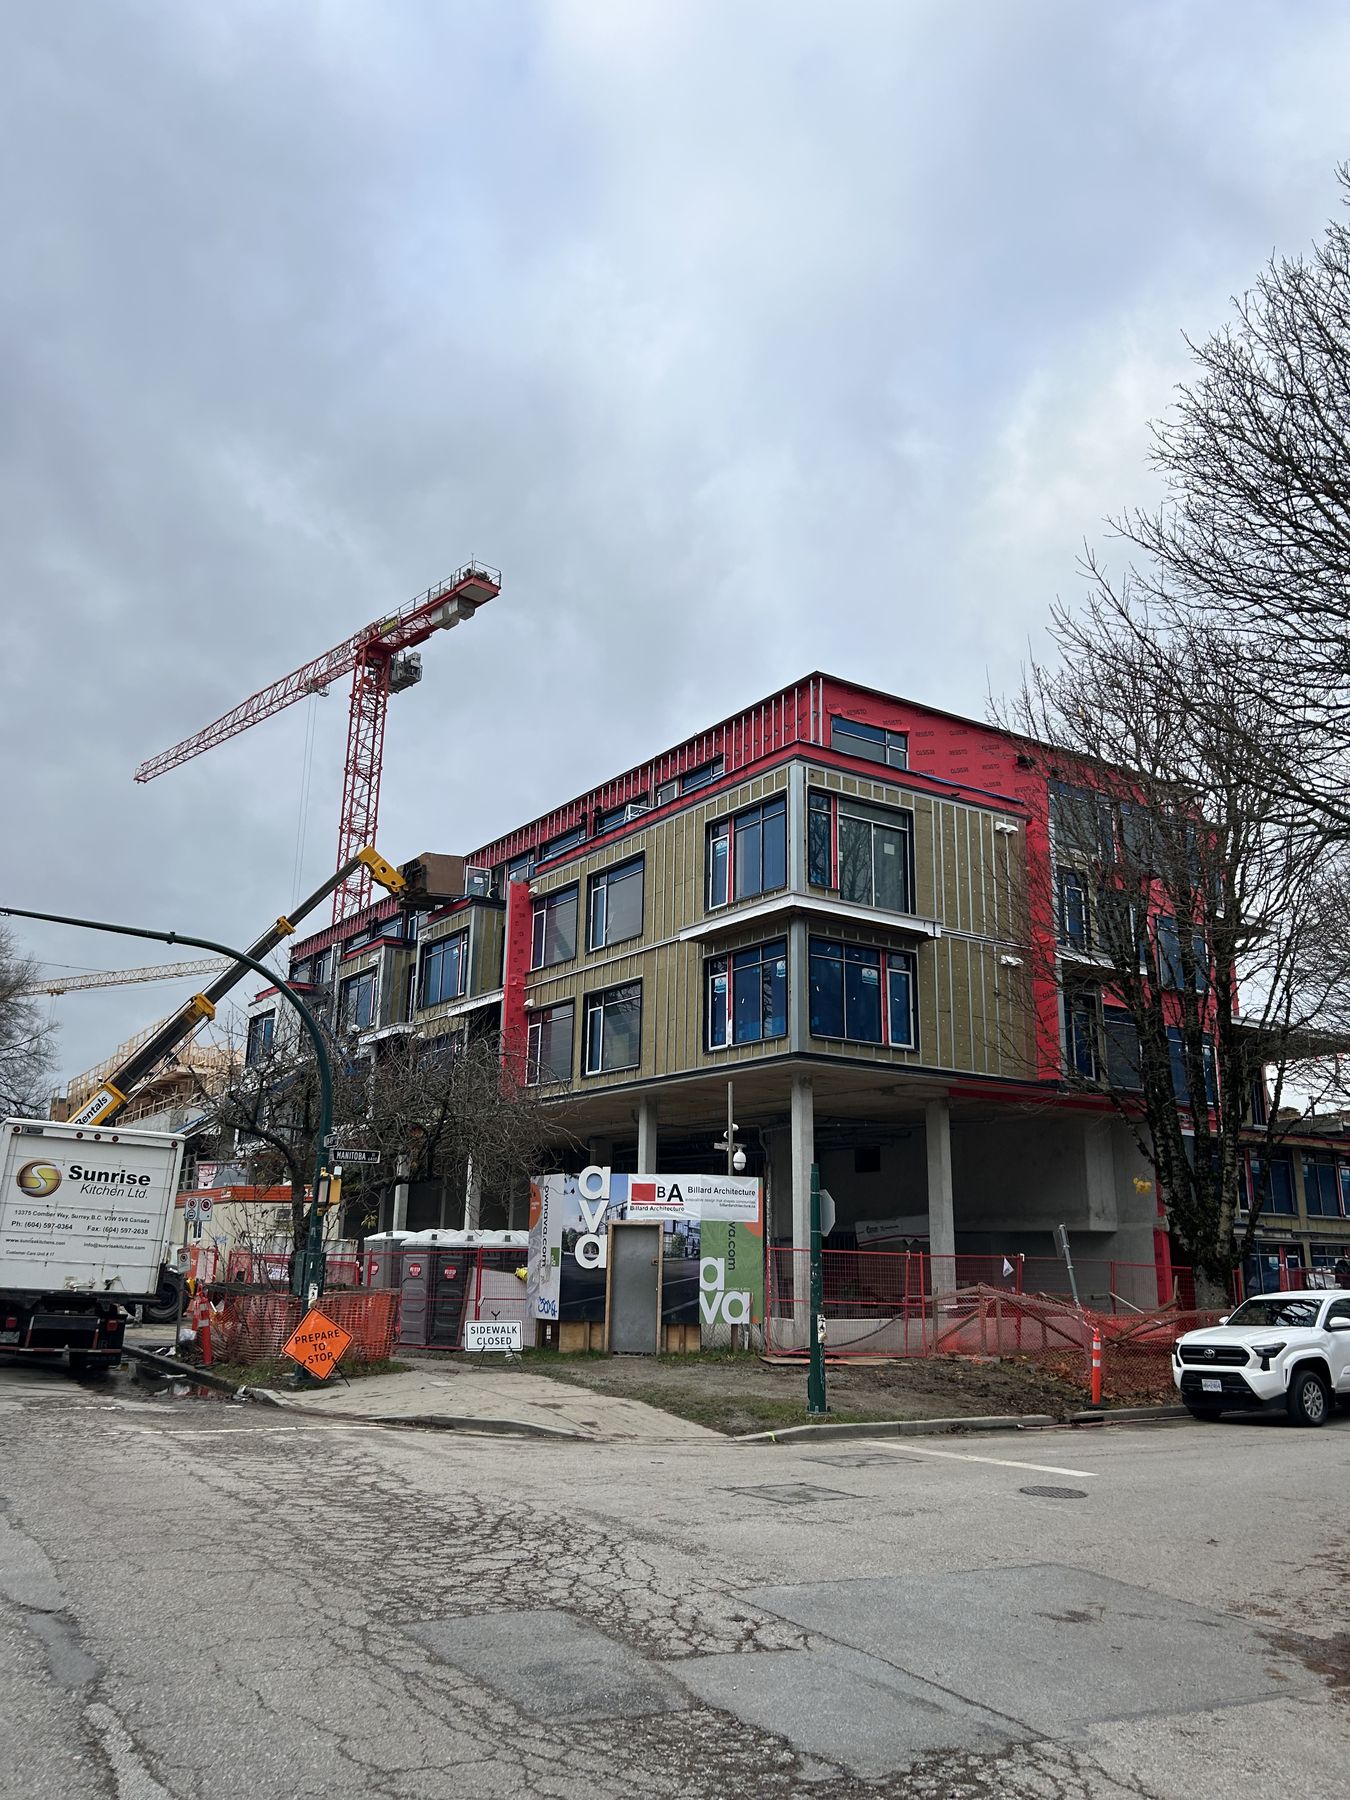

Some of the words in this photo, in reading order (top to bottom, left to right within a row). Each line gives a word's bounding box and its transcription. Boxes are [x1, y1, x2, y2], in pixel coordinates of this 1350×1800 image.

[74, 1096, 108, 1125] Rentals
[336, 1151, 367, 1161] MANITOBA
[68, 1165, 151, 1186] Sunrise
[80, 1183, 125, 1197] Kitchen
[127, 1187, 148, 1199] Ltd.
[687, 1186, 712, 1194] Billard
[713, 1187, 756, 1197] Architecture
[24, 1221, 42, 1229] (604)
[541, 1185, 549, 1267] ownava.com
[470, 1326, 518, 1335] SIDEWALK
[294, 1329, 340, 1344] PREPARE
[476, 1337, 512, 1346] CLOSED
[312, 1342, 326, 1352] TO
[307, 1352, 333, 1364] STOP
